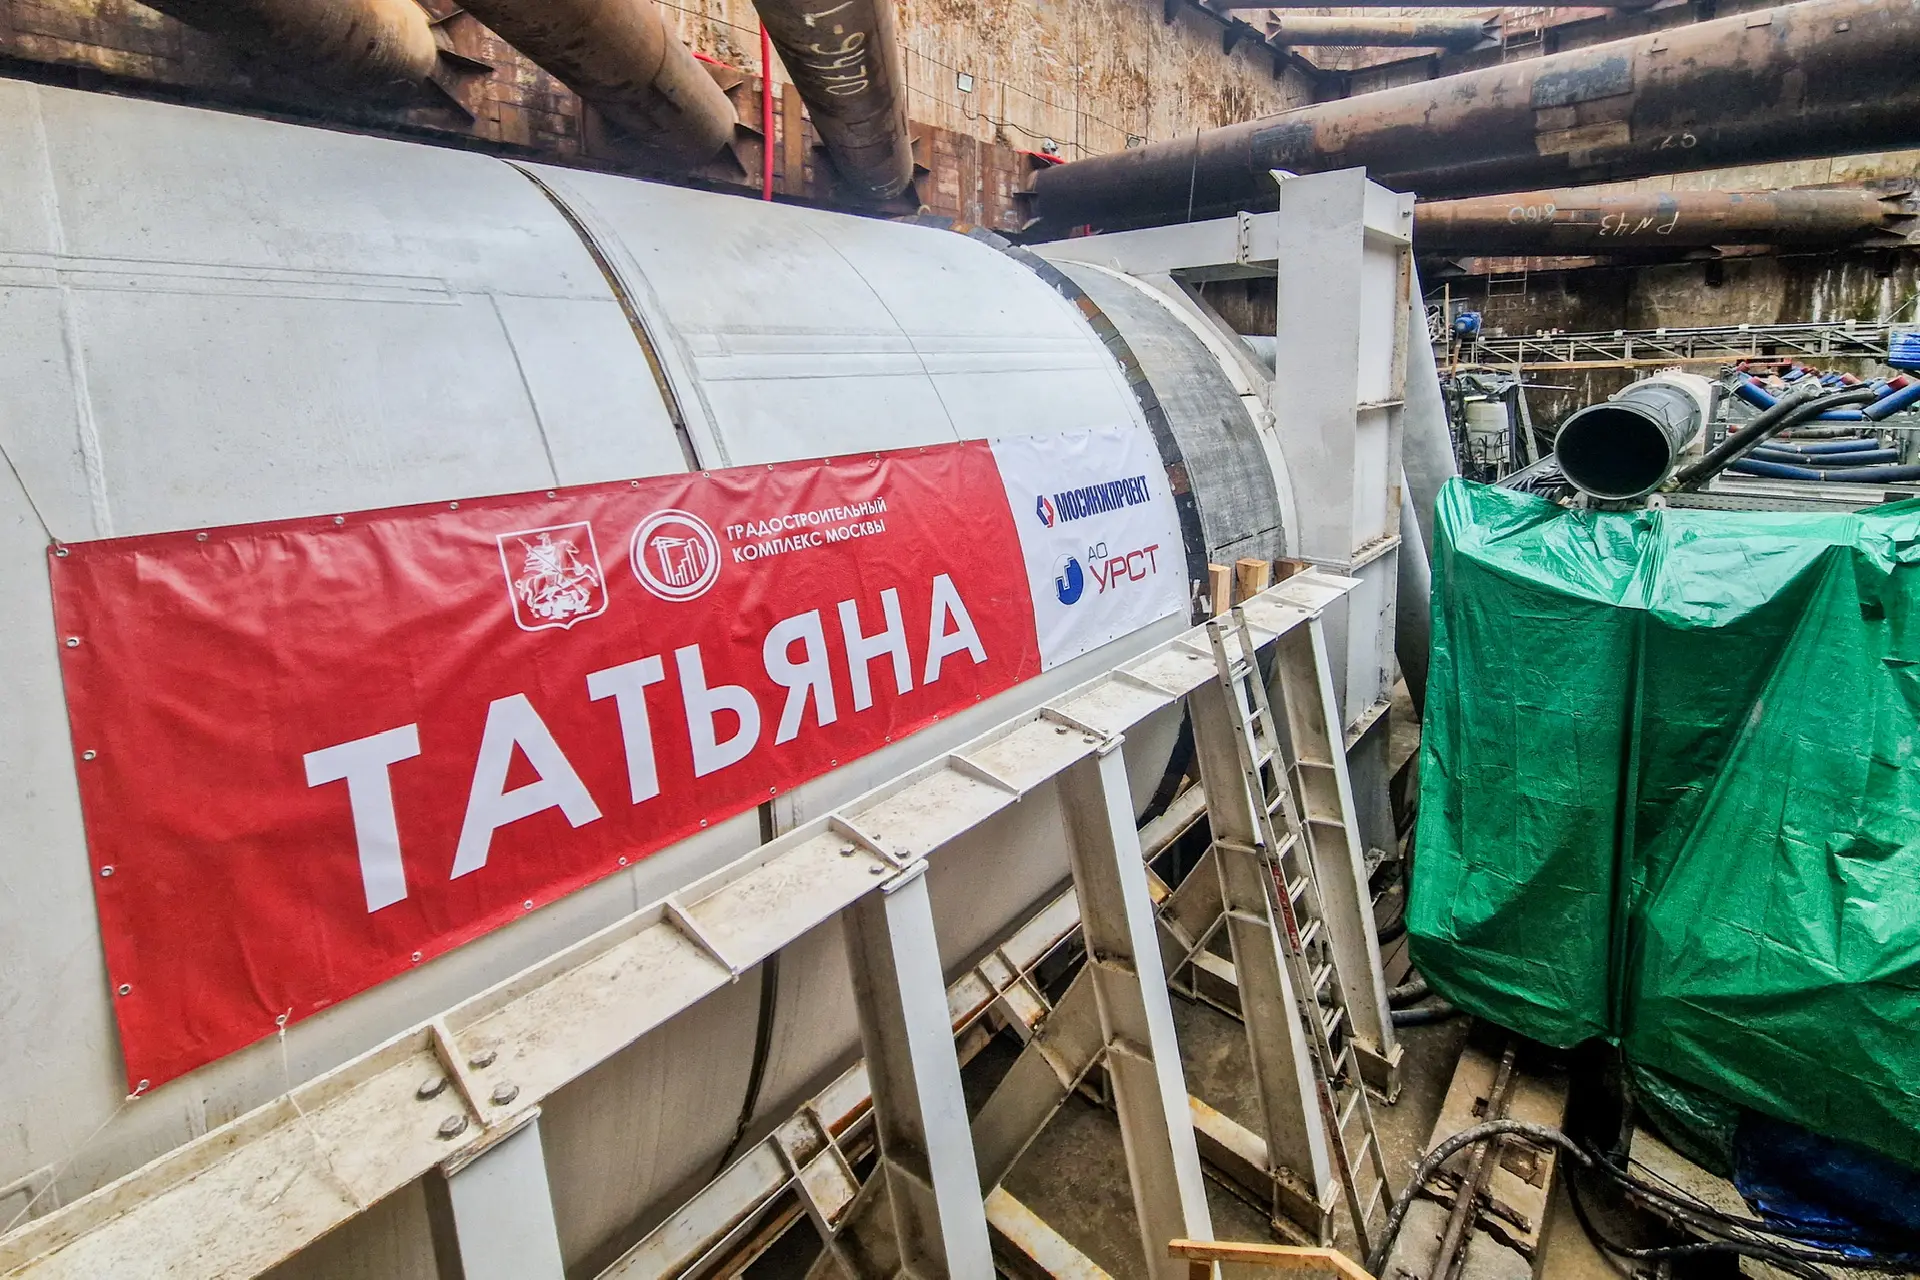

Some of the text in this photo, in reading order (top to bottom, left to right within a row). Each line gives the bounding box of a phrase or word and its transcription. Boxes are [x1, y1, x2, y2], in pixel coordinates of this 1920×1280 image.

[726, 496, 888, 542] ГРАДОСТРОИТЕЛЬНЫЙ
[1053, 475, 1151, 523] МОСИНЖПРОЕКТ
[731, 519, 886, 564] КОМПЛЕКС МОСКВЫ
[1088, 541, 1109, 562] АО
[1089, 543, 1159, 595] УРСТ
[303, 573, 988, 914] ТАТЬЯНА
